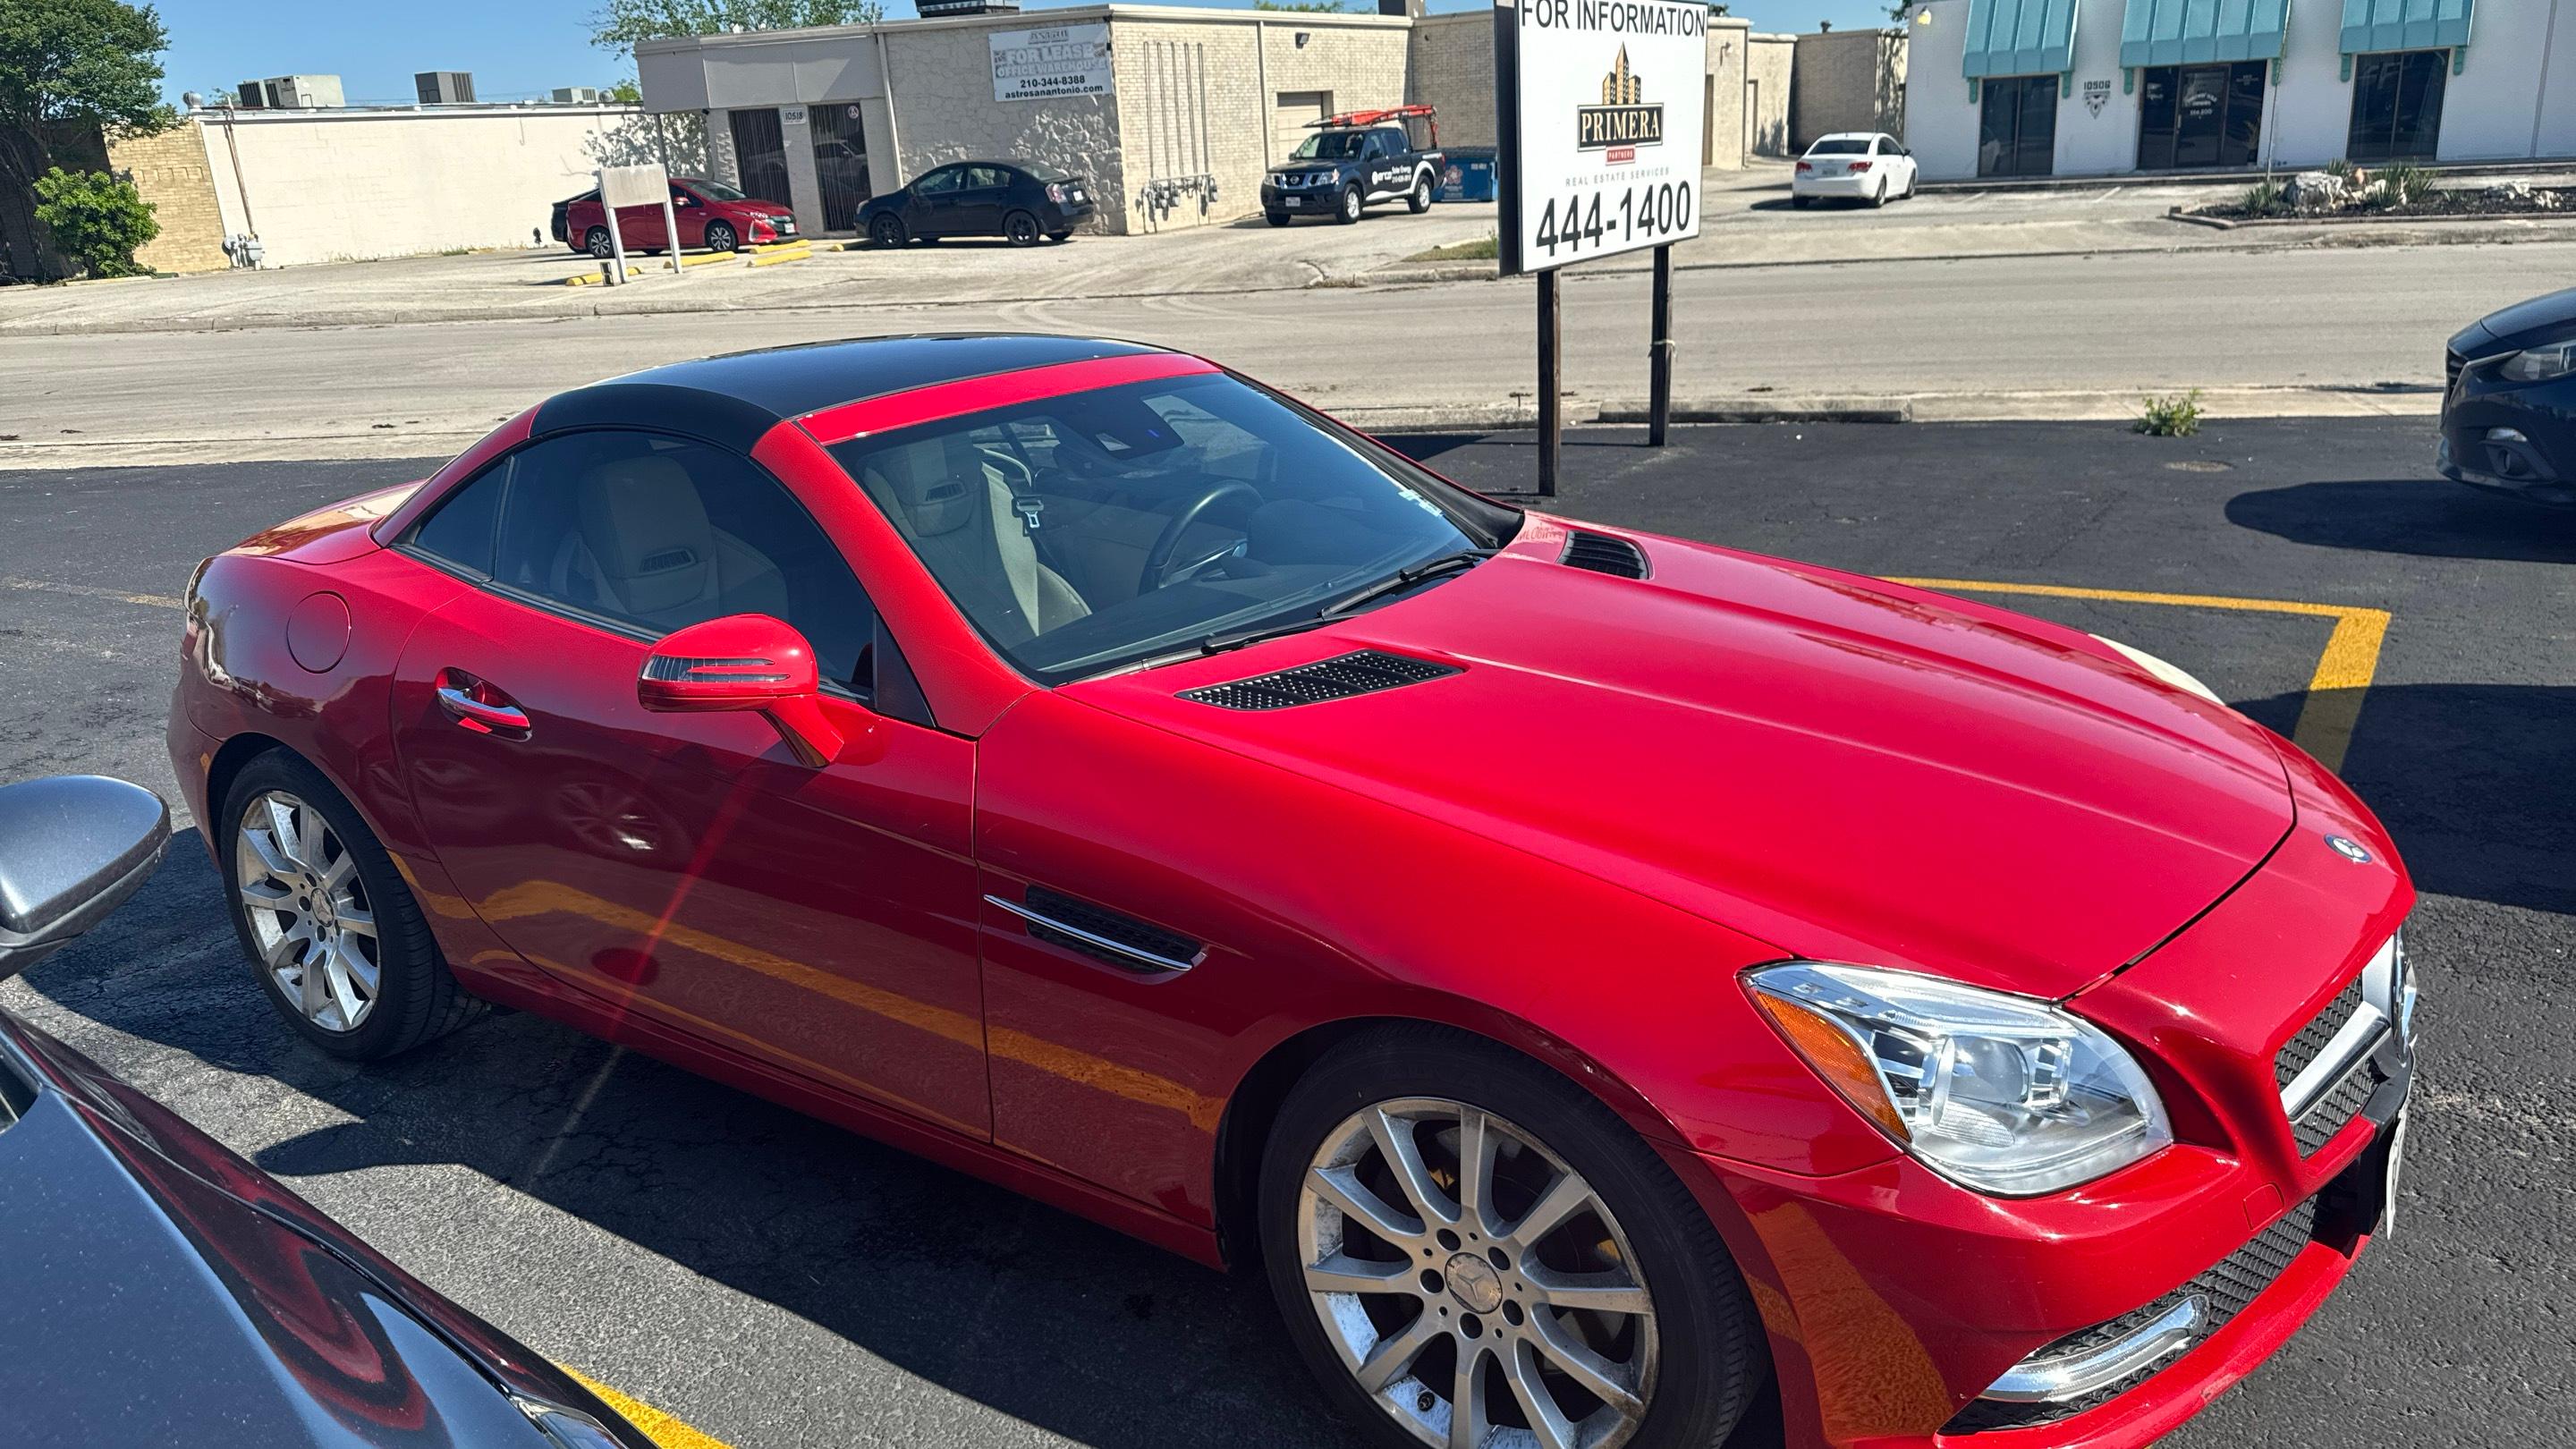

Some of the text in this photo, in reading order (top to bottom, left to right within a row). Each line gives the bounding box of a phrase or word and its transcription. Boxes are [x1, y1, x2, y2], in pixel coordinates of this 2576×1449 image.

[1521, 0, 1706, 37] FOR INFORMATION
[1006, 47, 1040, 65] FOR
[1042, 42, 1095, 63] LEASE
[996, 57, 1107, 78] OFFICE WAREHOUSE
[1004, 84, 1104, 98] astrosanantonio.com
[1020, 74, 1086, 88] 210-344-8388
[784, 111, 803, 121] 10518
[1580, 111, 1660, 142] PRIMERA
[1565, 166, 1670, 187] REAL ESTATE SERVICES
[1536, 180, 1690, 258] 444-1400
